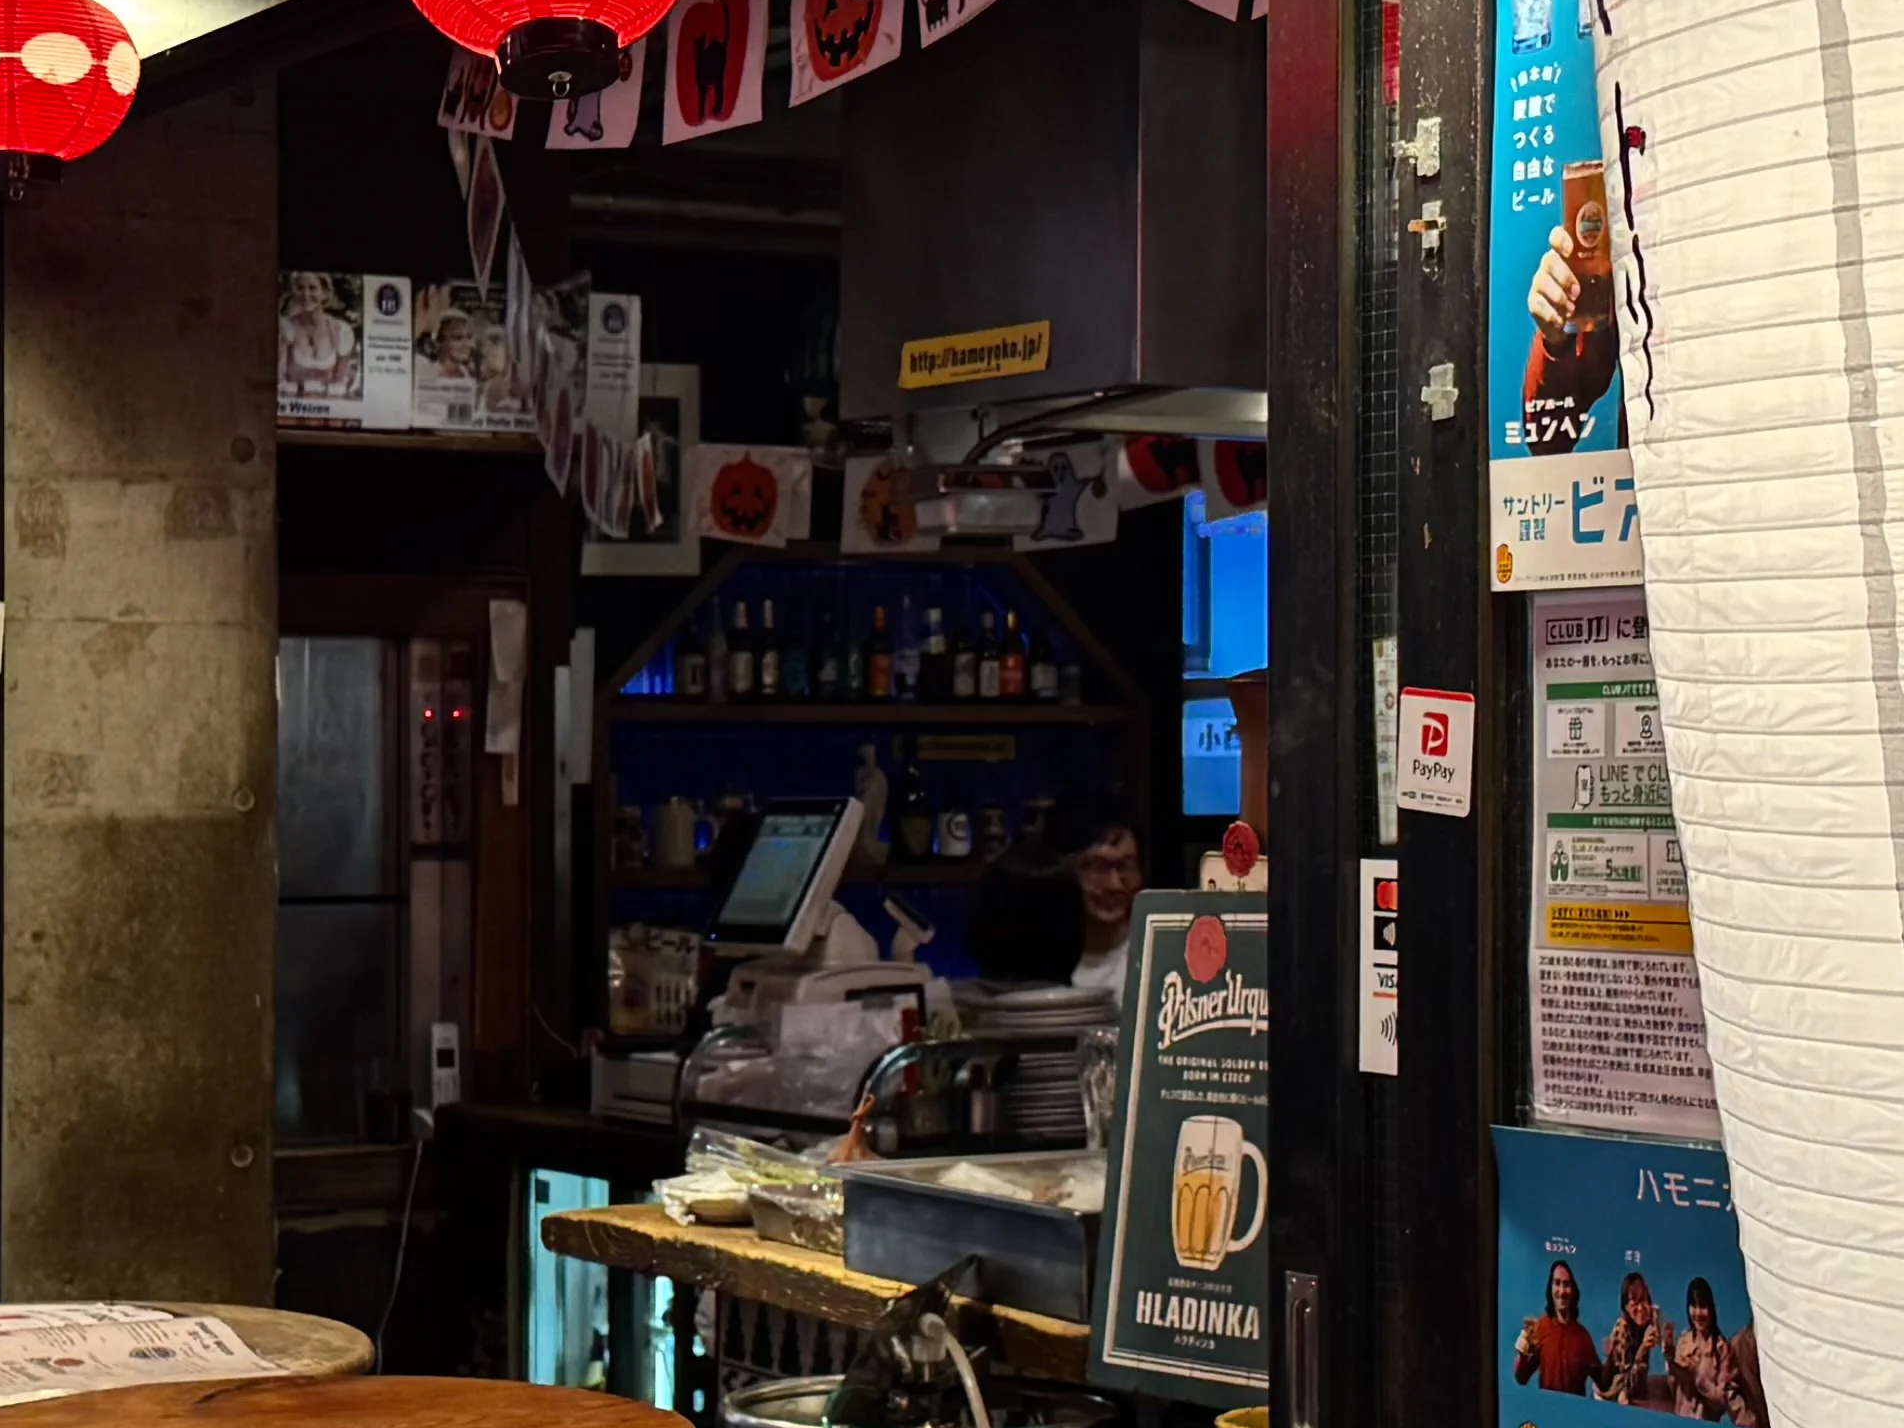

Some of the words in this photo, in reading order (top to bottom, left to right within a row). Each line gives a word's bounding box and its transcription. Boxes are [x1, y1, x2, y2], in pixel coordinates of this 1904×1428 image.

[1512, 124, 1556, 150] つくる
[1512, 187, 1556, 212] ビール
[1504, 412, 1596, 444] ミュンヘン
[1503, 492, 1566, 517] サントリー
[1549, 623, 1583, 639] CLUB
[1412, 758, 1455, 783] PayPay
[1599, 764, 1629, 782] LINE
[1377, 971, 1399, 989] VIS
[1157, 970, 1228, 1051] Pilsner
[1135, 1289, 1260, 1340] HLADINKA
